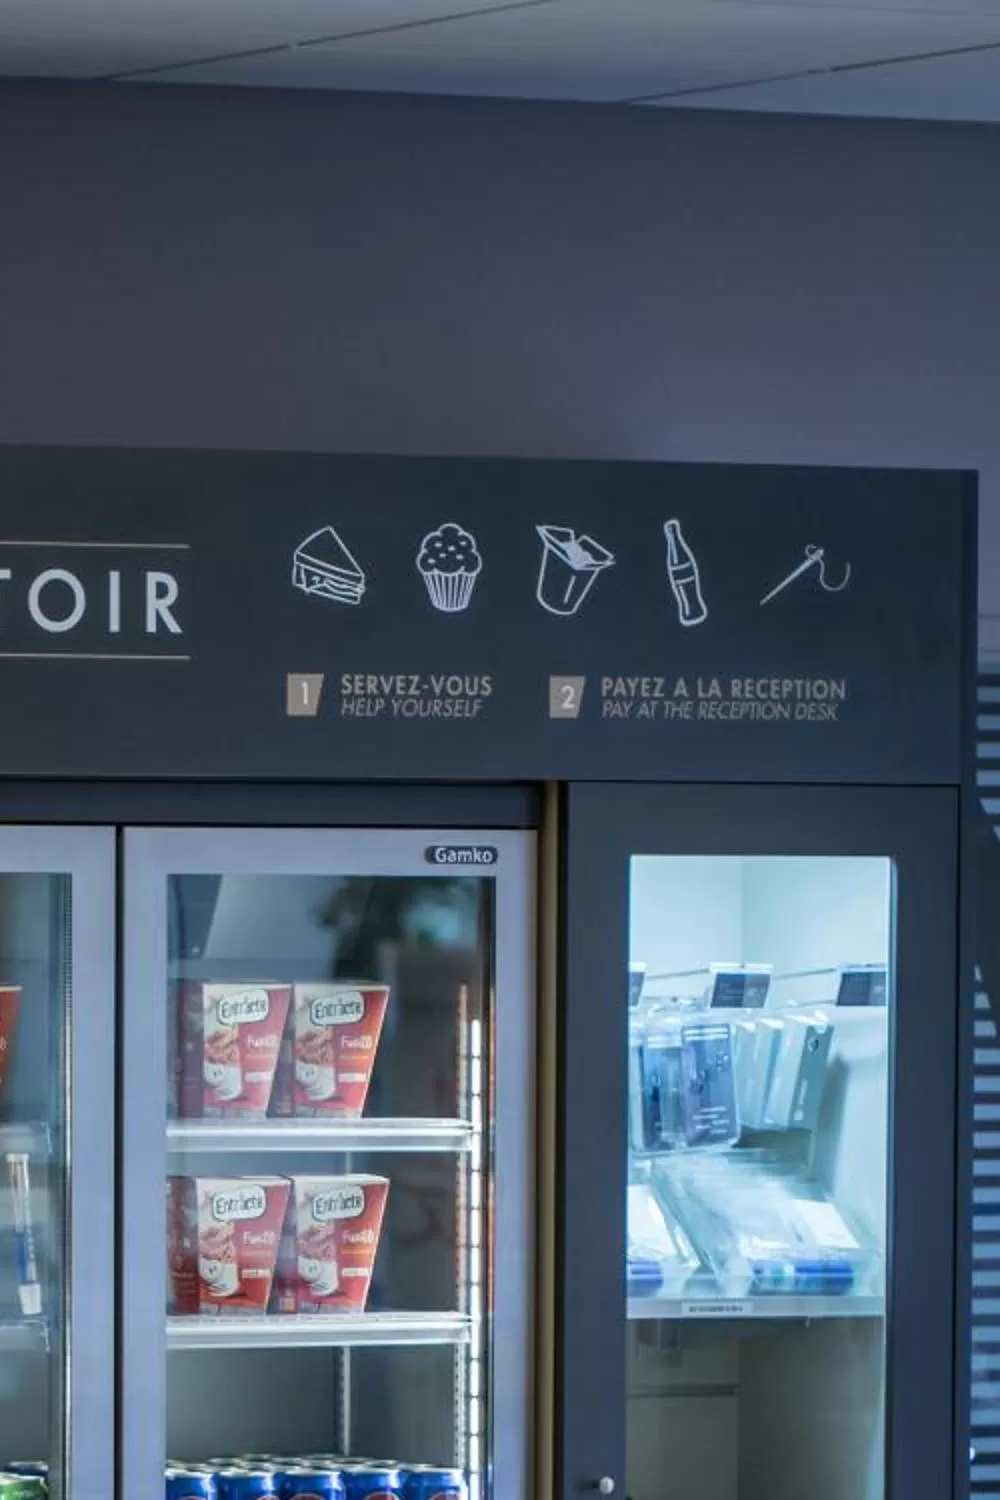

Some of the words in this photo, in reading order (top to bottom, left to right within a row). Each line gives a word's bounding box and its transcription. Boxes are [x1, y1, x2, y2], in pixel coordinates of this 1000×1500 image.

[301, 681, 309, 705] 1
[341, 673, 493, 697] SERVEZ-VOUS
[561, 684, 576, 709] 2
[600, 676, 665, 698] PAYEZ
[672, 677, 690, 699] A
[697, 677, 722, 699] LA
[730, 678, 846, 700] RECEPTION
[341, 699, 386, 718] HELP
[391, 699, 484, 718] YOURSELF
[601, 700, 634, 719] PAY
[635, 701, 660, 719] AT
[663, 701, 694, 720] THE
[697, 701, 791, 721] RECEPTION
[794, 702, 840, 721] DESK
[434, 846, 493, 864] Gamko
